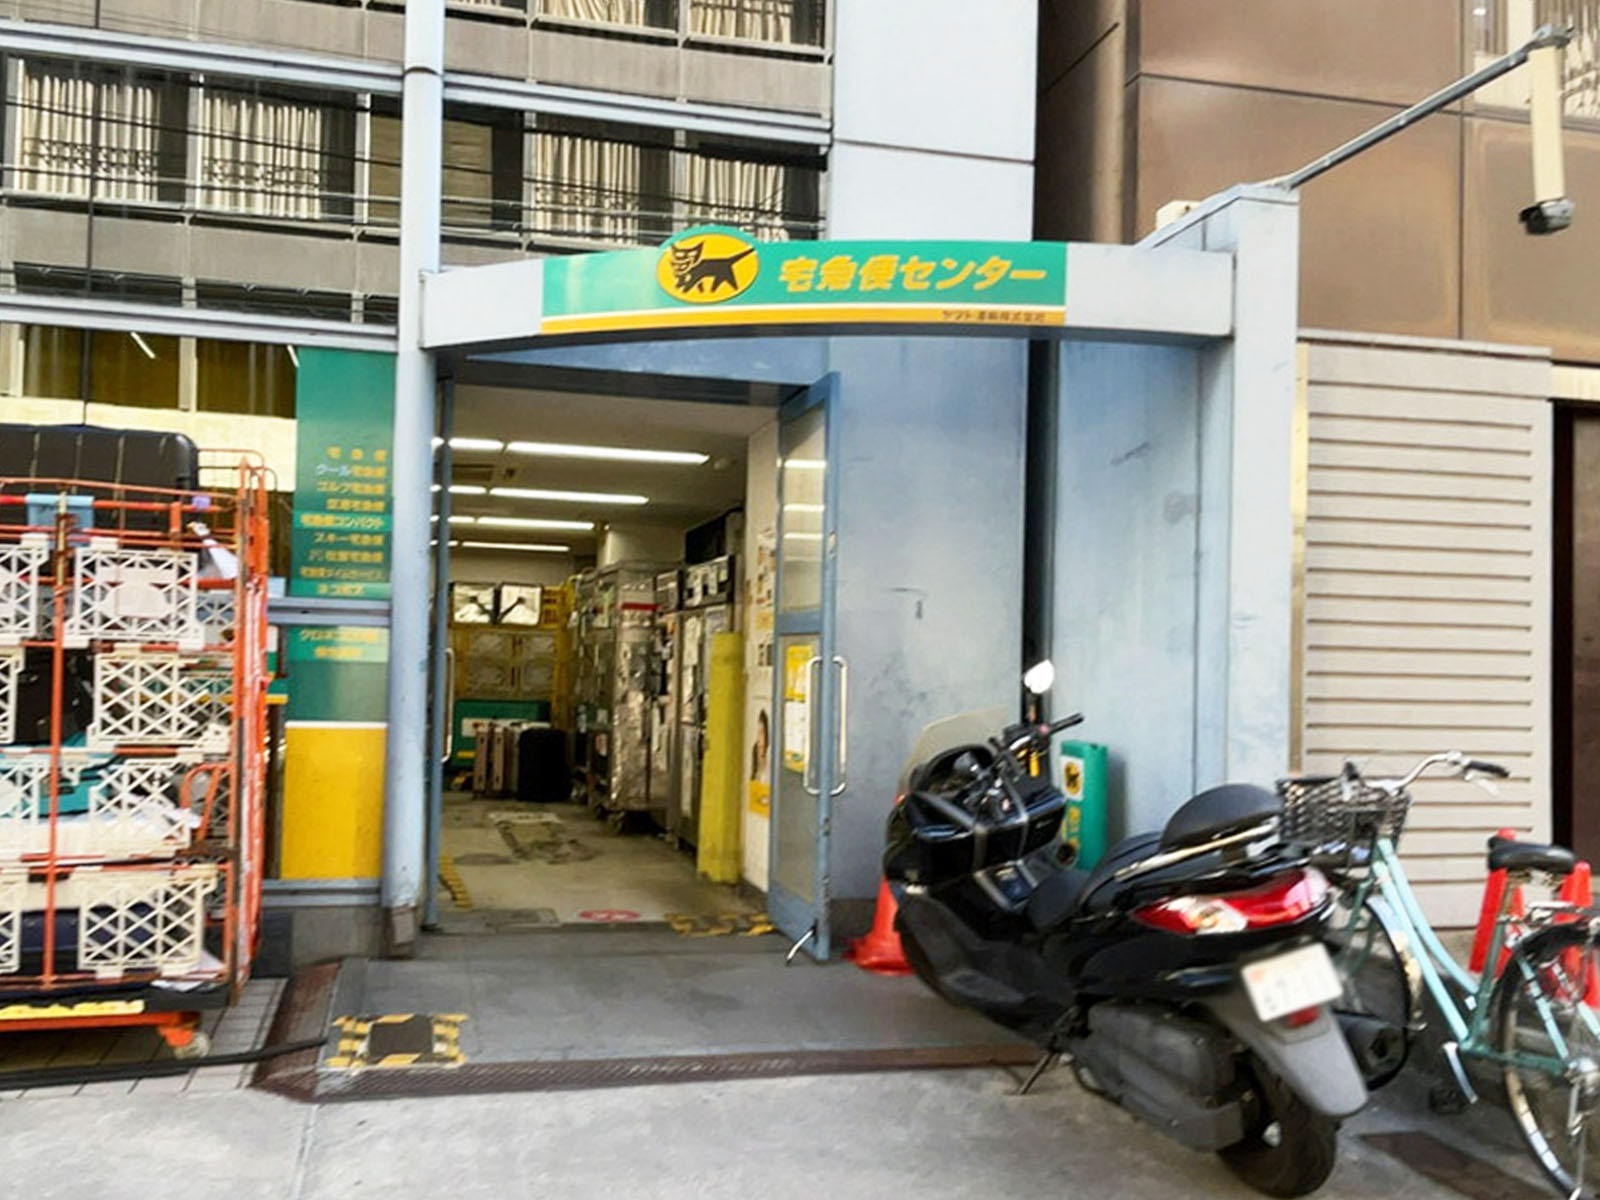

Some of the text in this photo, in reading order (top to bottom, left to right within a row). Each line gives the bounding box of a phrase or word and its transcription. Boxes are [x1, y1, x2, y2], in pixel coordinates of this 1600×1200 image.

[778, 254, 1047, 293] 宅急便センター
